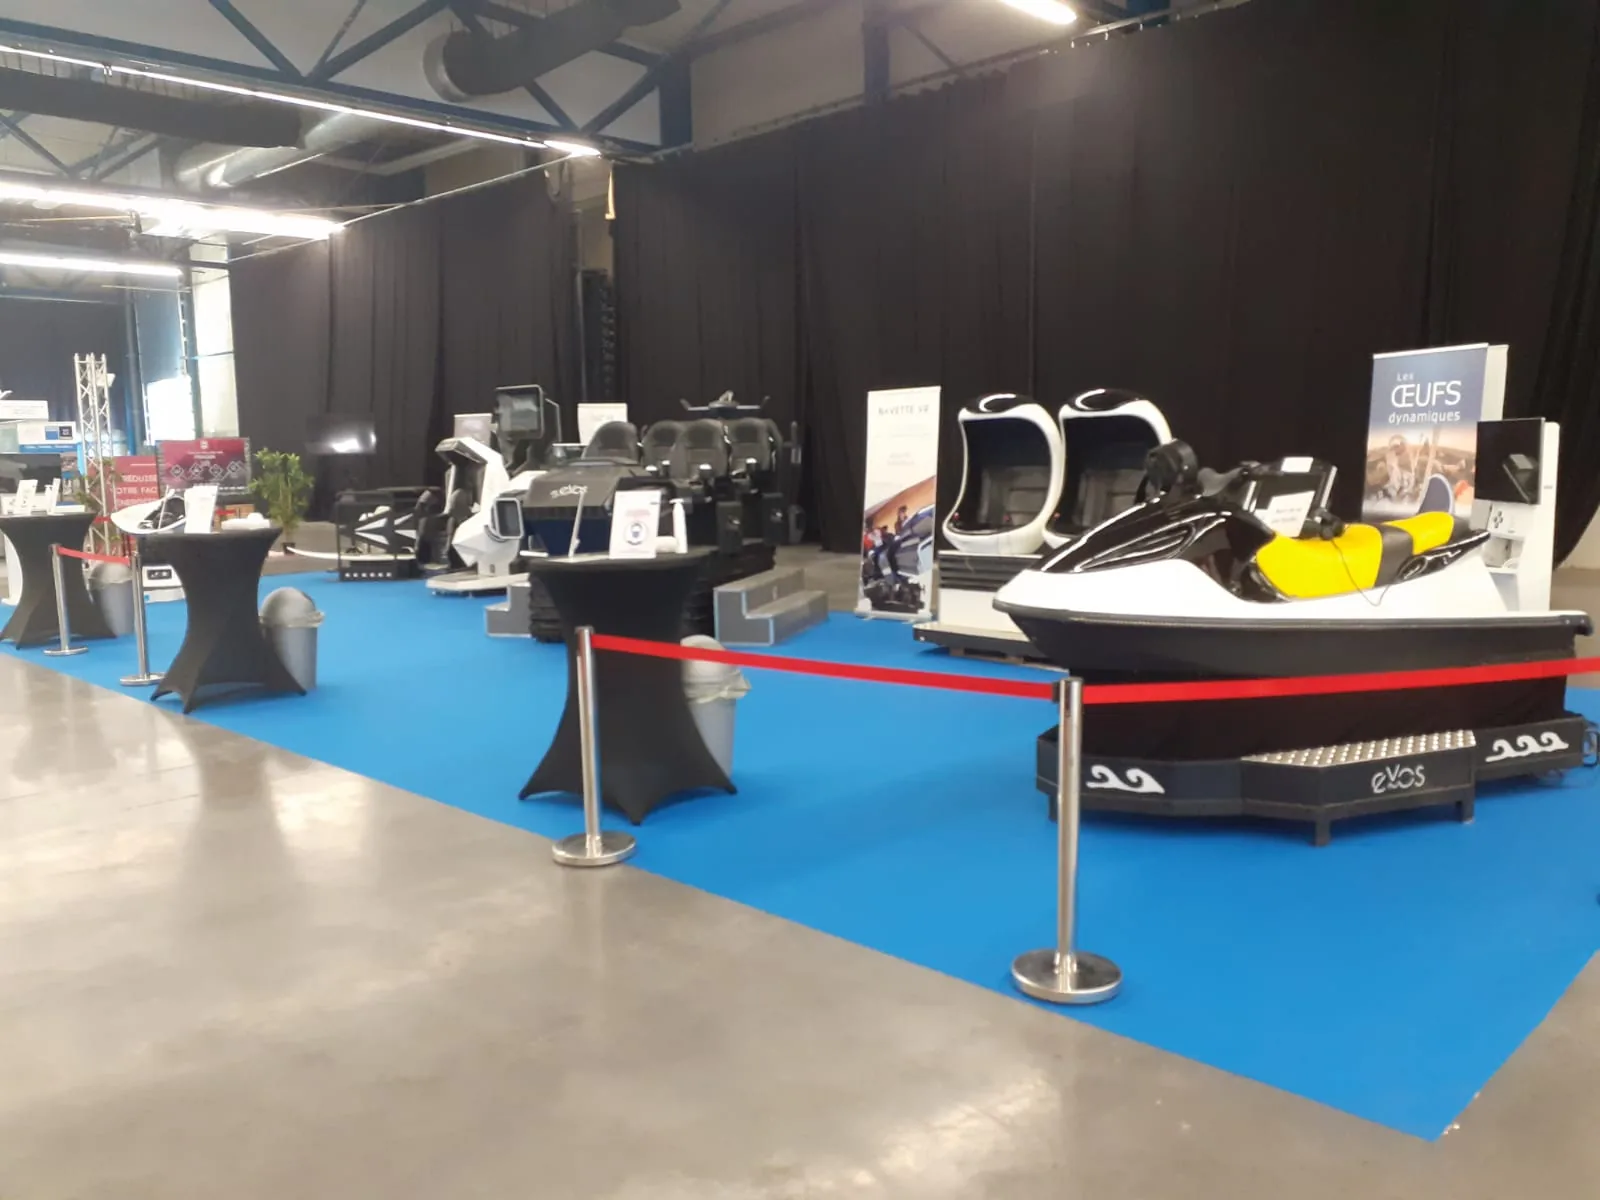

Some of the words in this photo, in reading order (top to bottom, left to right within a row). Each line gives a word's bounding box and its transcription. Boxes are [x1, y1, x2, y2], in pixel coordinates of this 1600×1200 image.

[1396, 372, 1414, 381] Les
[1391, 380, 1461, 408] ŒUFS
[1388, 410, 1460, 425] dynamiques
